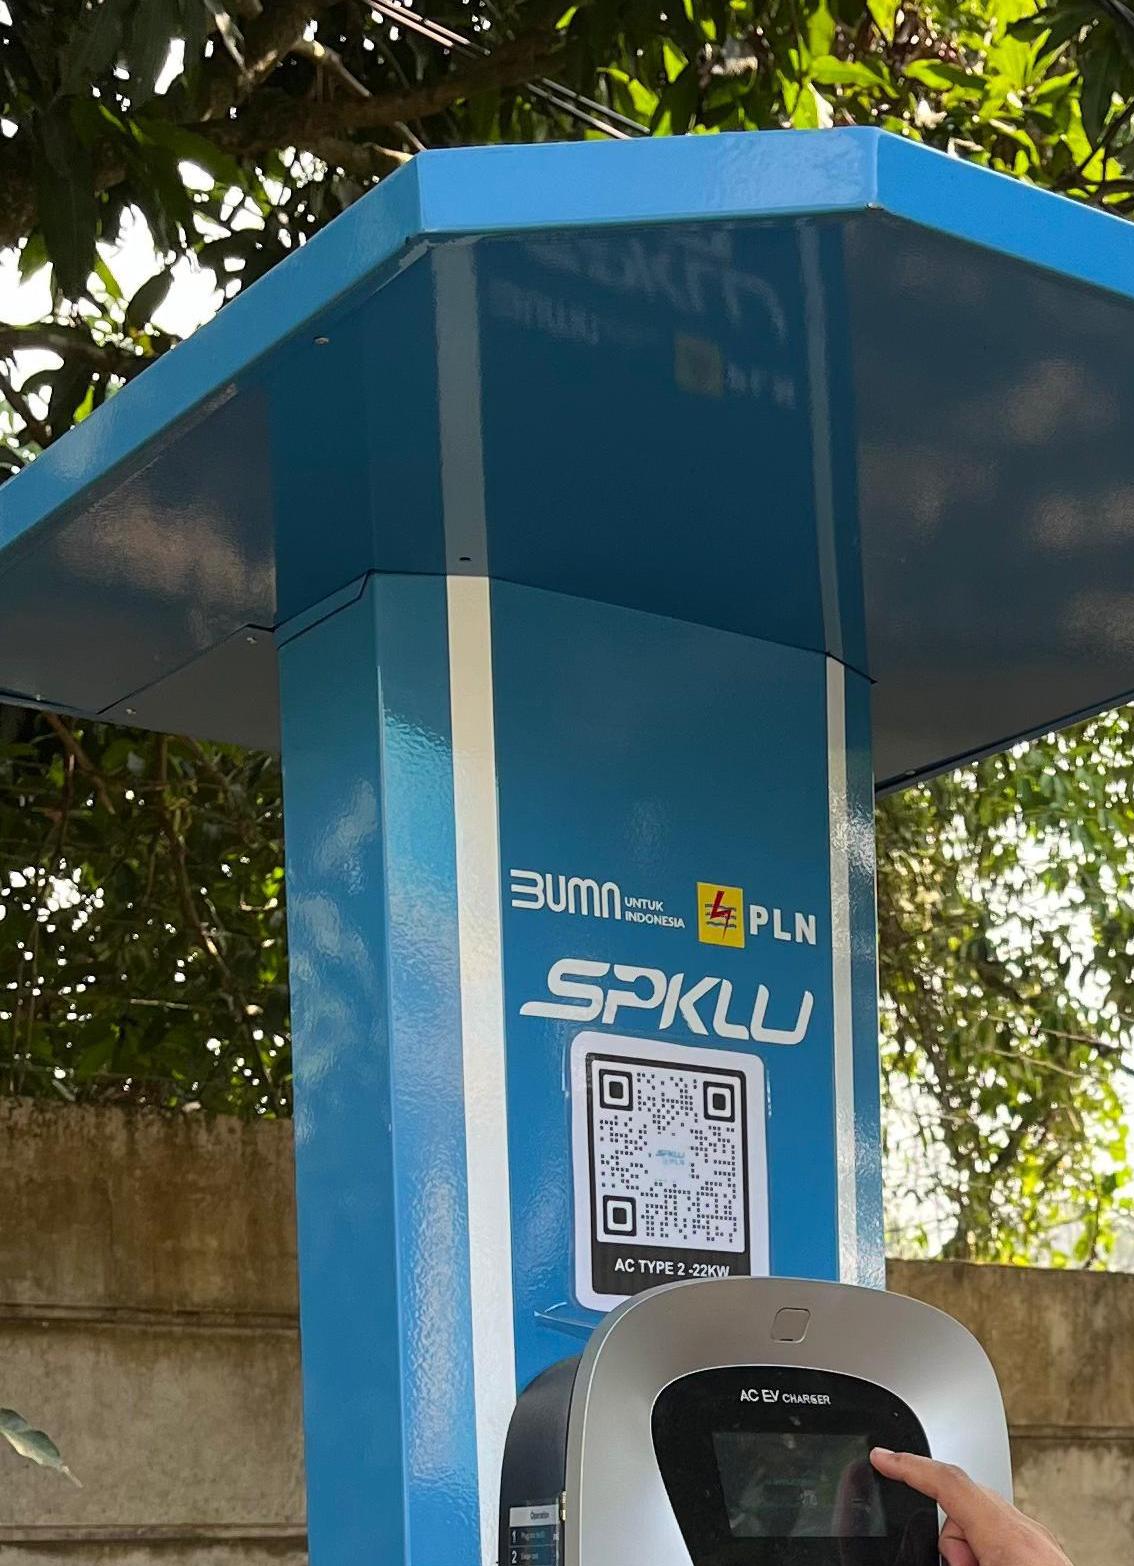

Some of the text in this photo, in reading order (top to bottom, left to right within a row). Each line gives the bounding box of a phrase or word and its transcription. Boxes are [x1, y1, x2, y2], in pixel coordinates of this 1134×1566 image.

[510, 869, 621, 920] BUMN
[624, 896, 664, 912] UNTUK
[625, 911, 686, 929] INDONESIA
[750, 904, 817, 946] PLN
[519, 958, 814, 1045] SPKLU
[614, 1258, 635, 1273] AC
[638, 1259, 674, 1275] TYPE
[677, 1263, 686, 1276] 2
[740, 1388, 831, 1406] AC EV CHARGER
[512, 1530, 517, 1543] 1
[511, 1551, 518, 1564] 2
